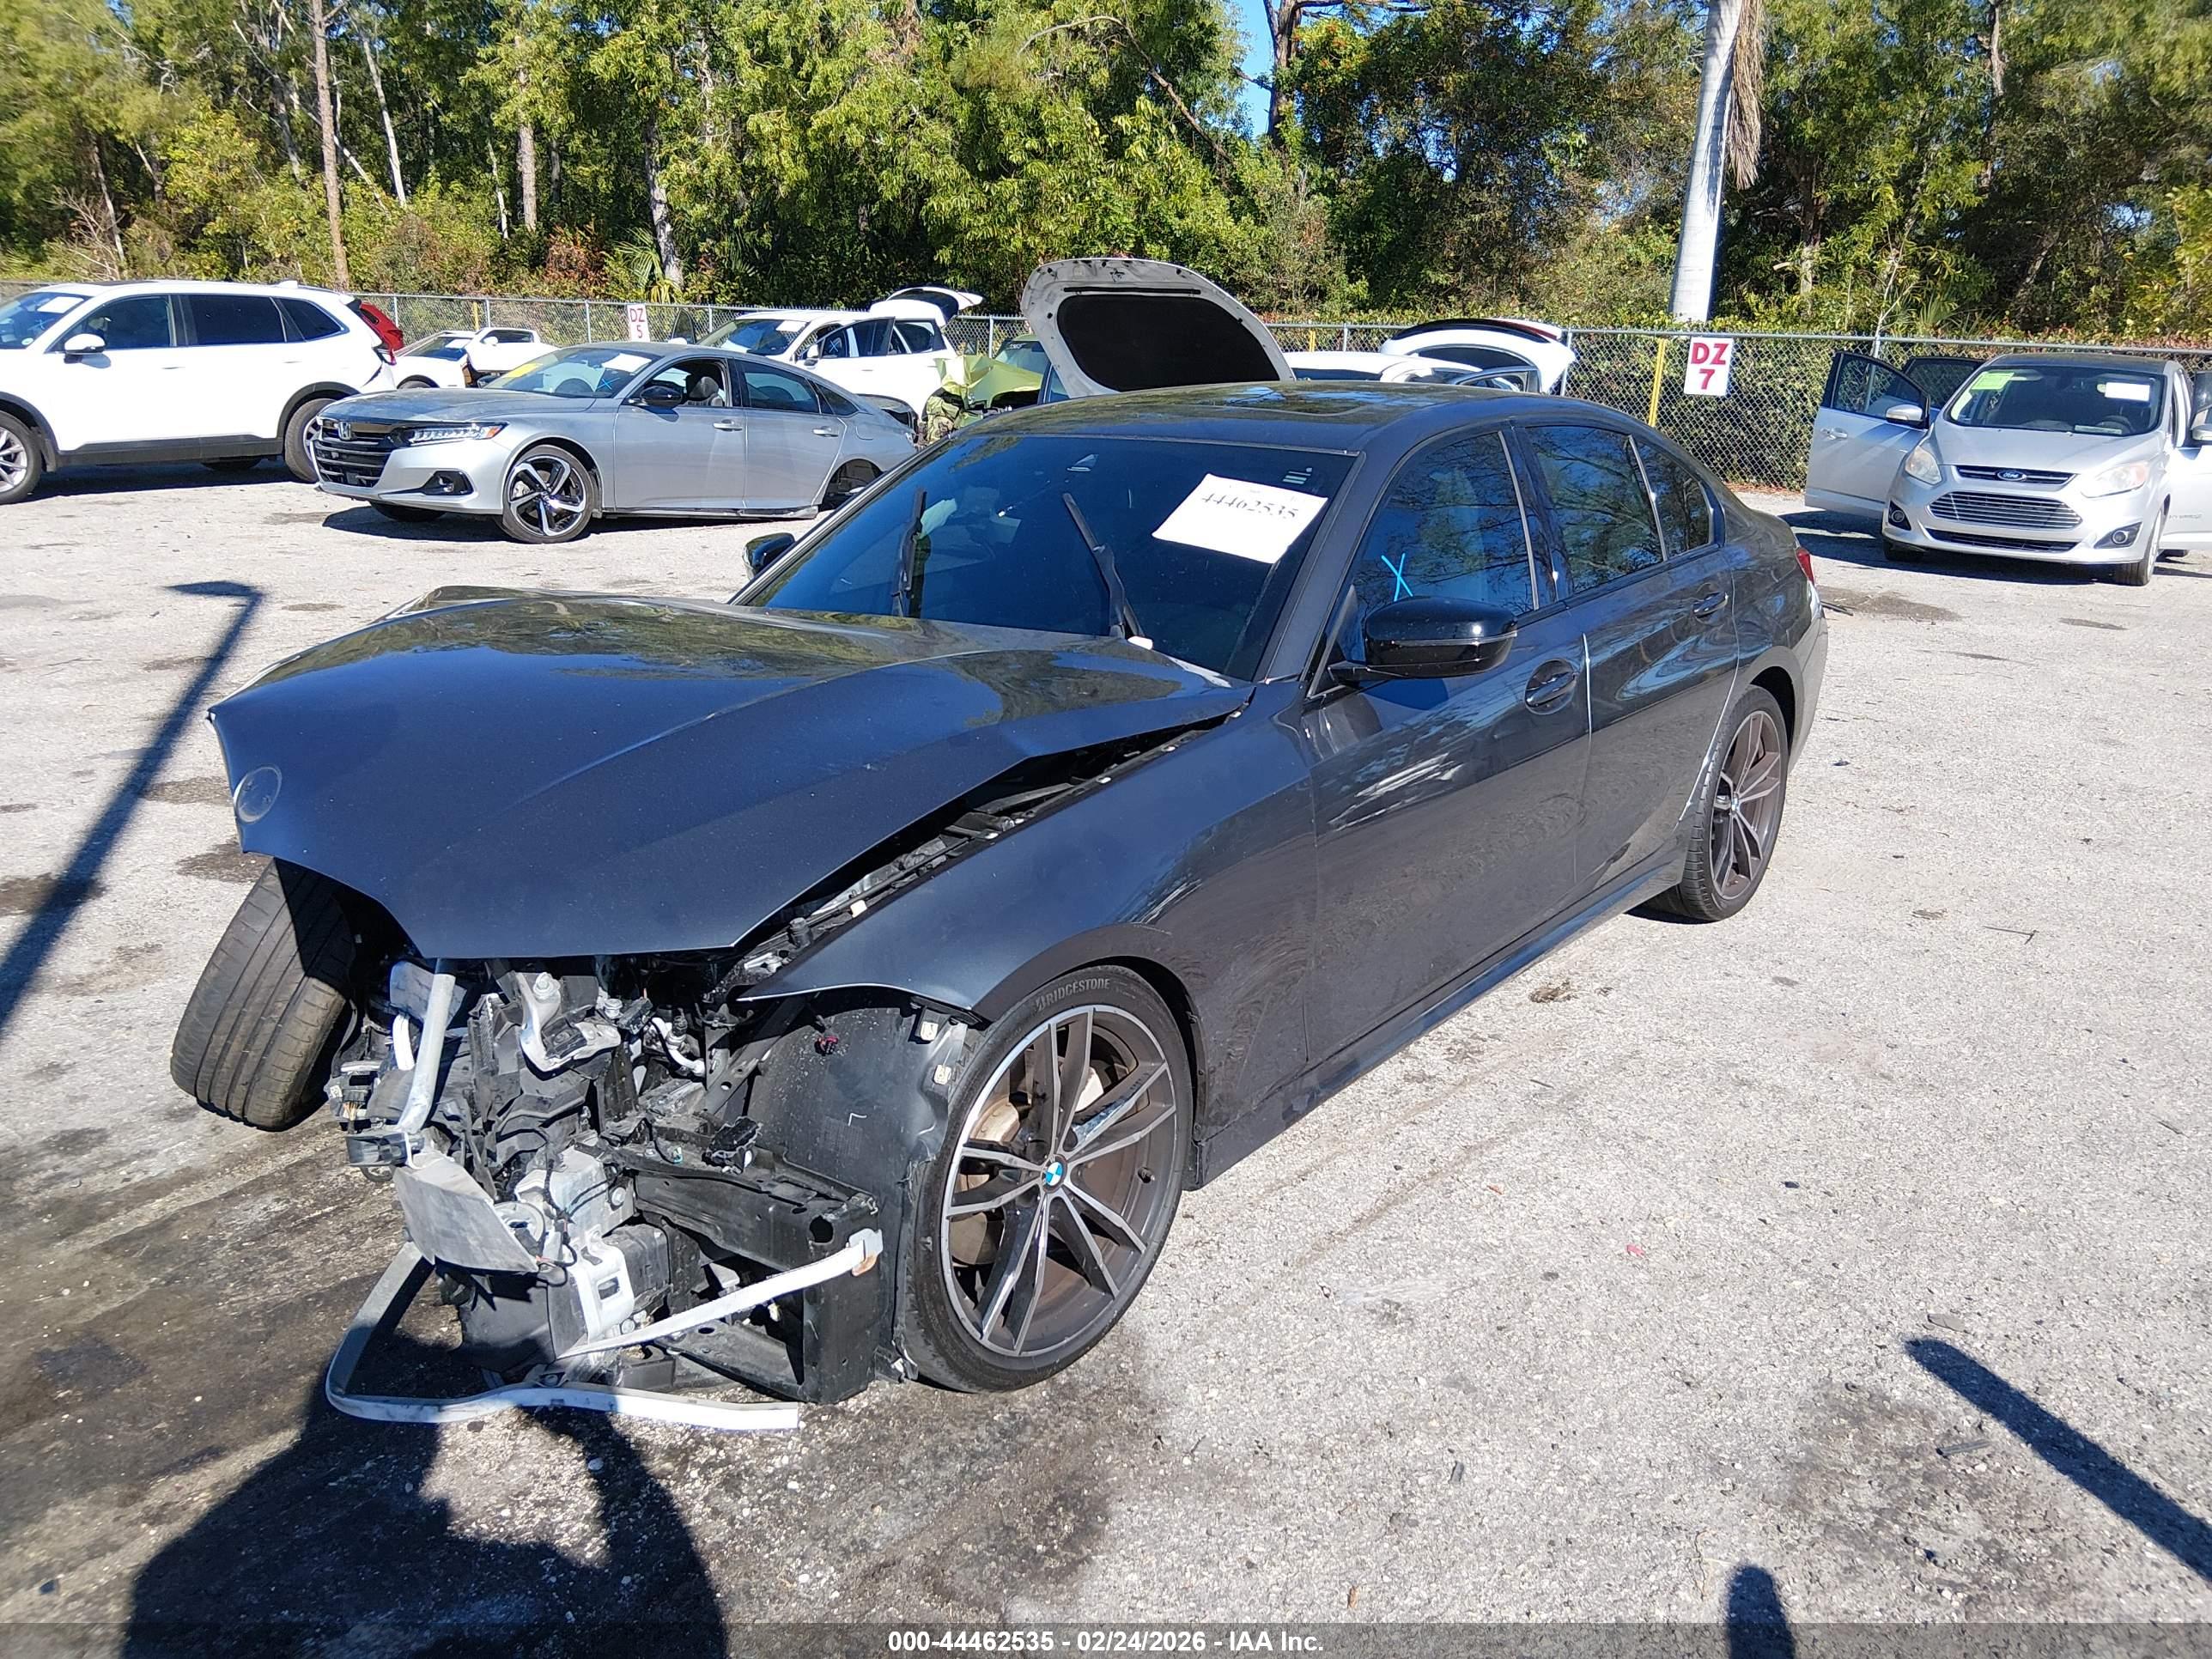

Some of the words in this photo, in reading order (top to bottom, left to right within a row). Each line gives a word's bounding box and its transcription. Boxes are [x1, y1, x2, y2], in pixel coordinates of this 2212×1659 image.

[629, 308, 645, 322] DZ
[636, 325, 642, 338] 5
[1691, 343, 1729, 365] DZ
[1699, 368, 1715, 390] 7
